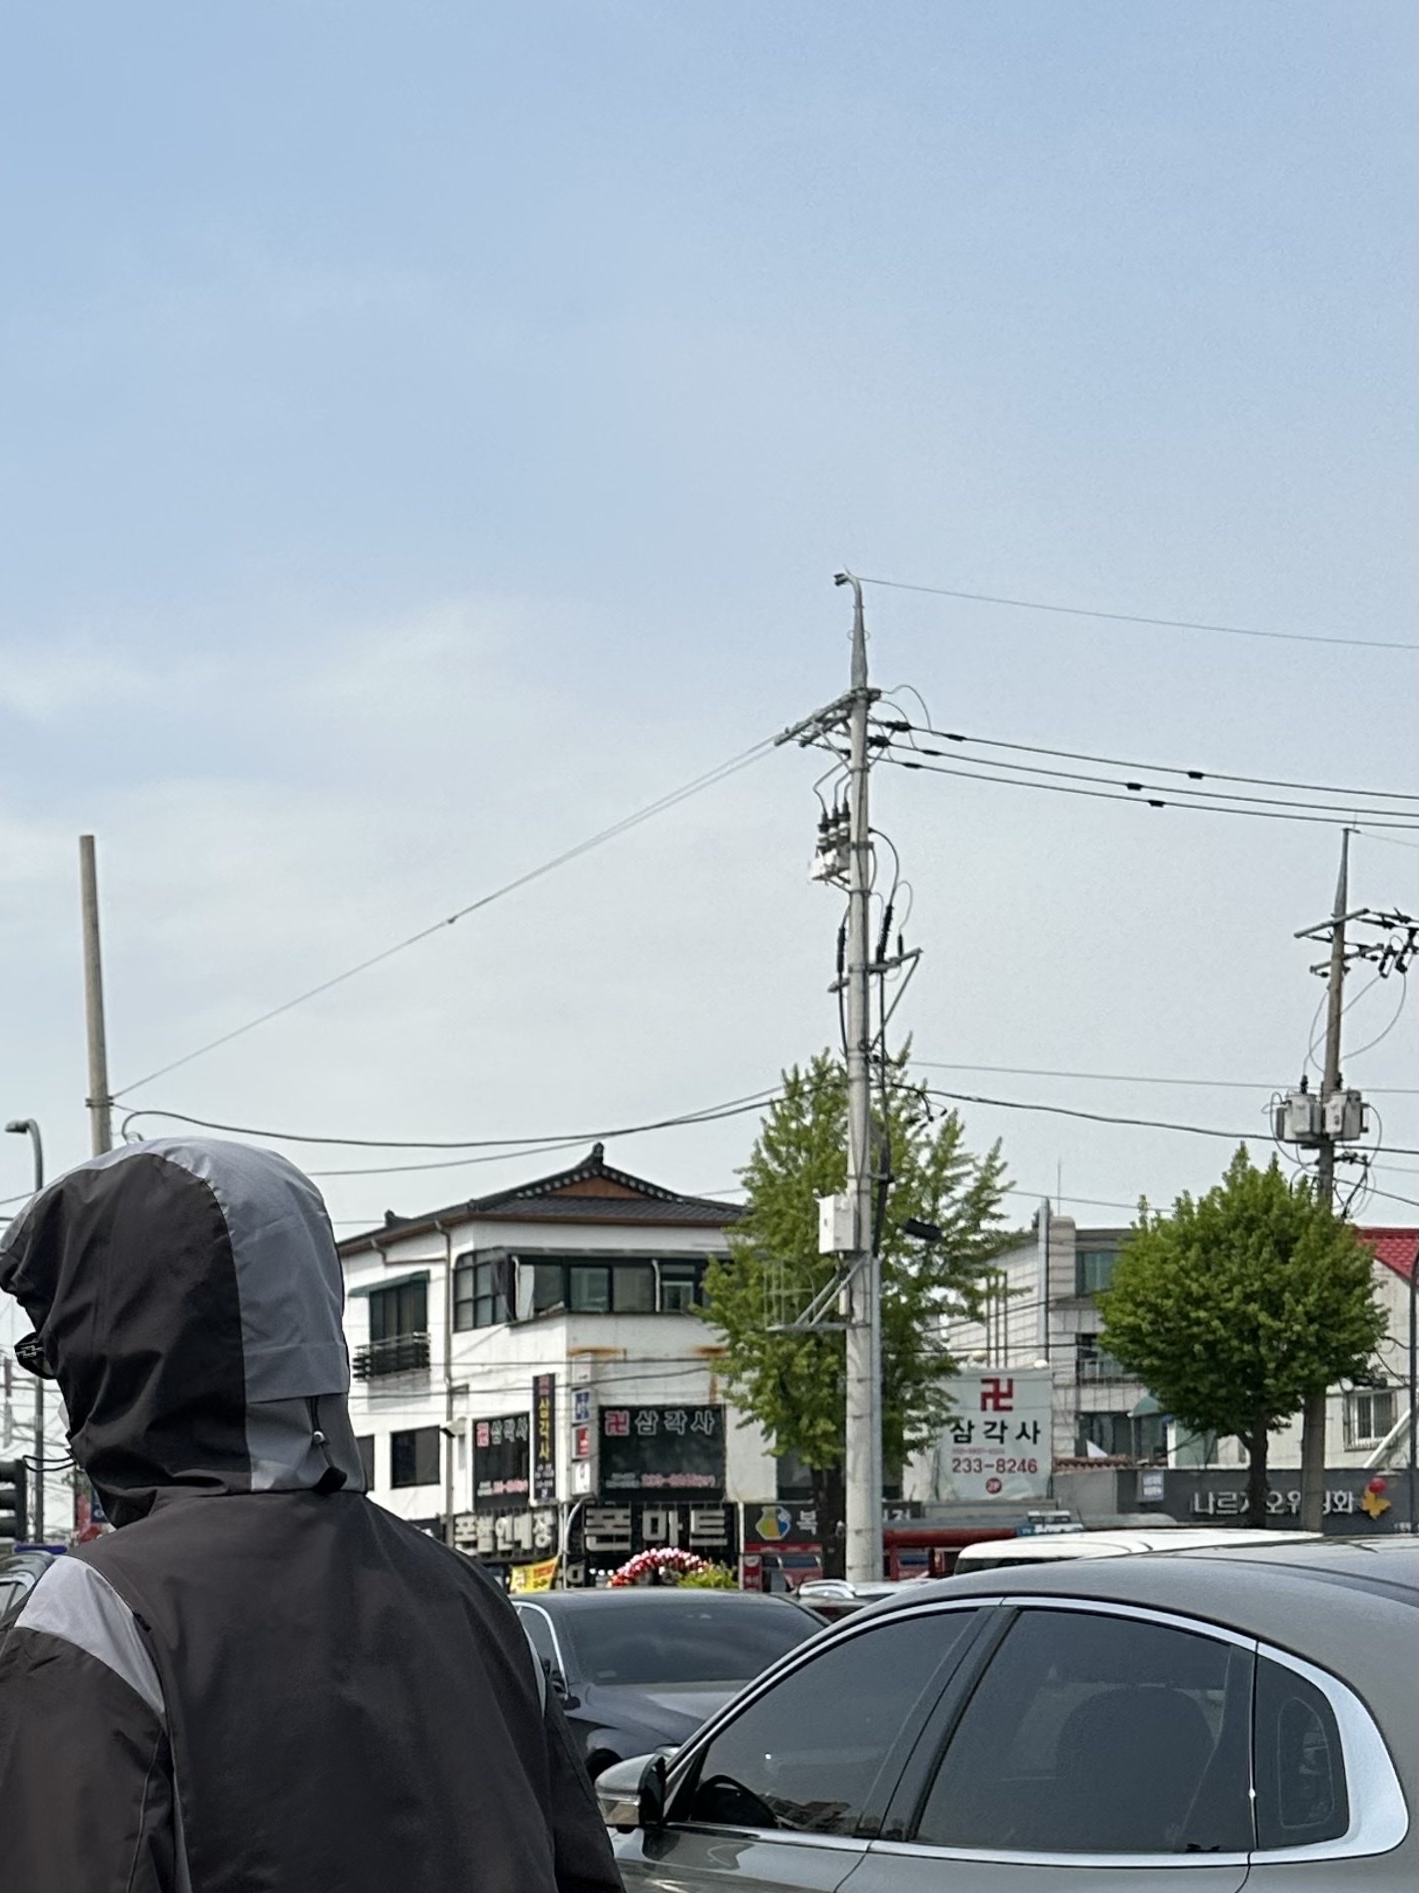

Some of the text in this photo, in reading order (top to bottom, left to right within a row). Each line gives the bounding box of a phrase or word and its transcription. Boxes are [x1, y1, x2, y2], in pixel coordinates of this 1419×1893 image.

[635, 1409, 715, 1436] 삼각사
[949, 1419, 1042, 1445] 삼각사
[952, 1457, 1039, 1475] 233-8246
[584, 1508, 728, 1552] 폰마트
